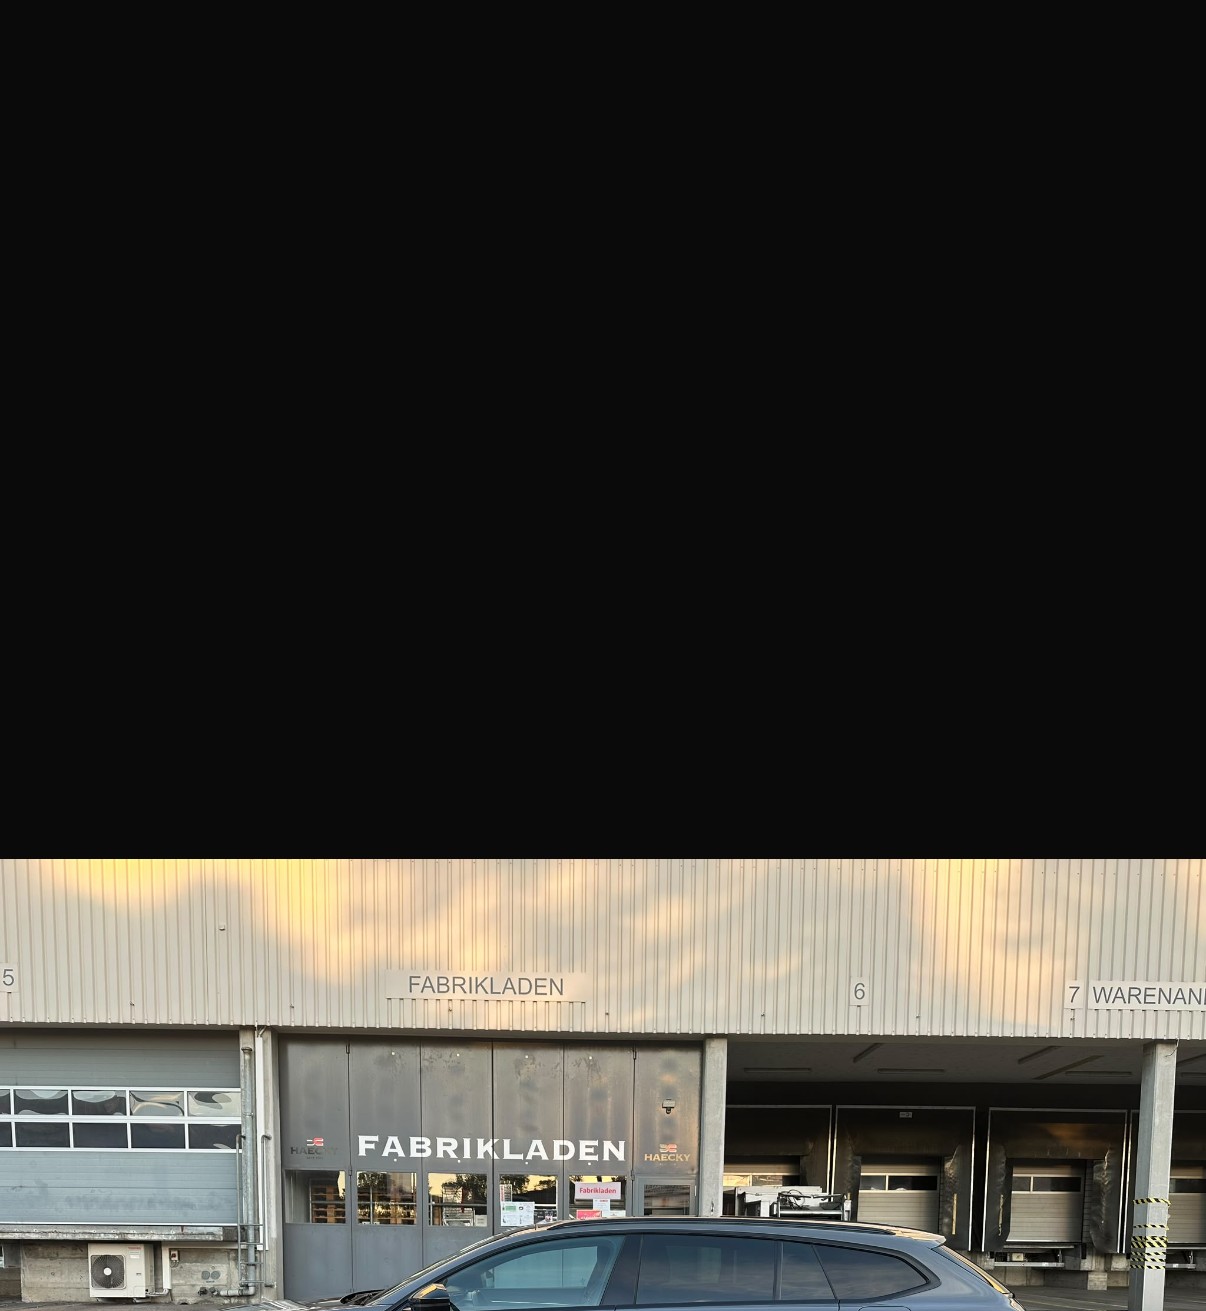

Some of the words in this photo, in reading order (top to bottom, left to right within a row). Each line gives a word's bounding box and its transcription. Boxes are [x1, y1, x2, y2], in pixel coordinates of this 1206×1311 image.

[3, 968, 14, 986] 5
[409, 975, 563, 995] FABRIKLADEN
[854, 982, 865, 1000] 6
[1069, 986, 1080, 1003] 7
[1093, 986, 1206, 1005] WARENAN
[290, 1146, 338, 1155] HAEC
[357, 1135, 626, 1161] FABRIKLADEN
[644, 1153, 690, 1161] HAECKY
